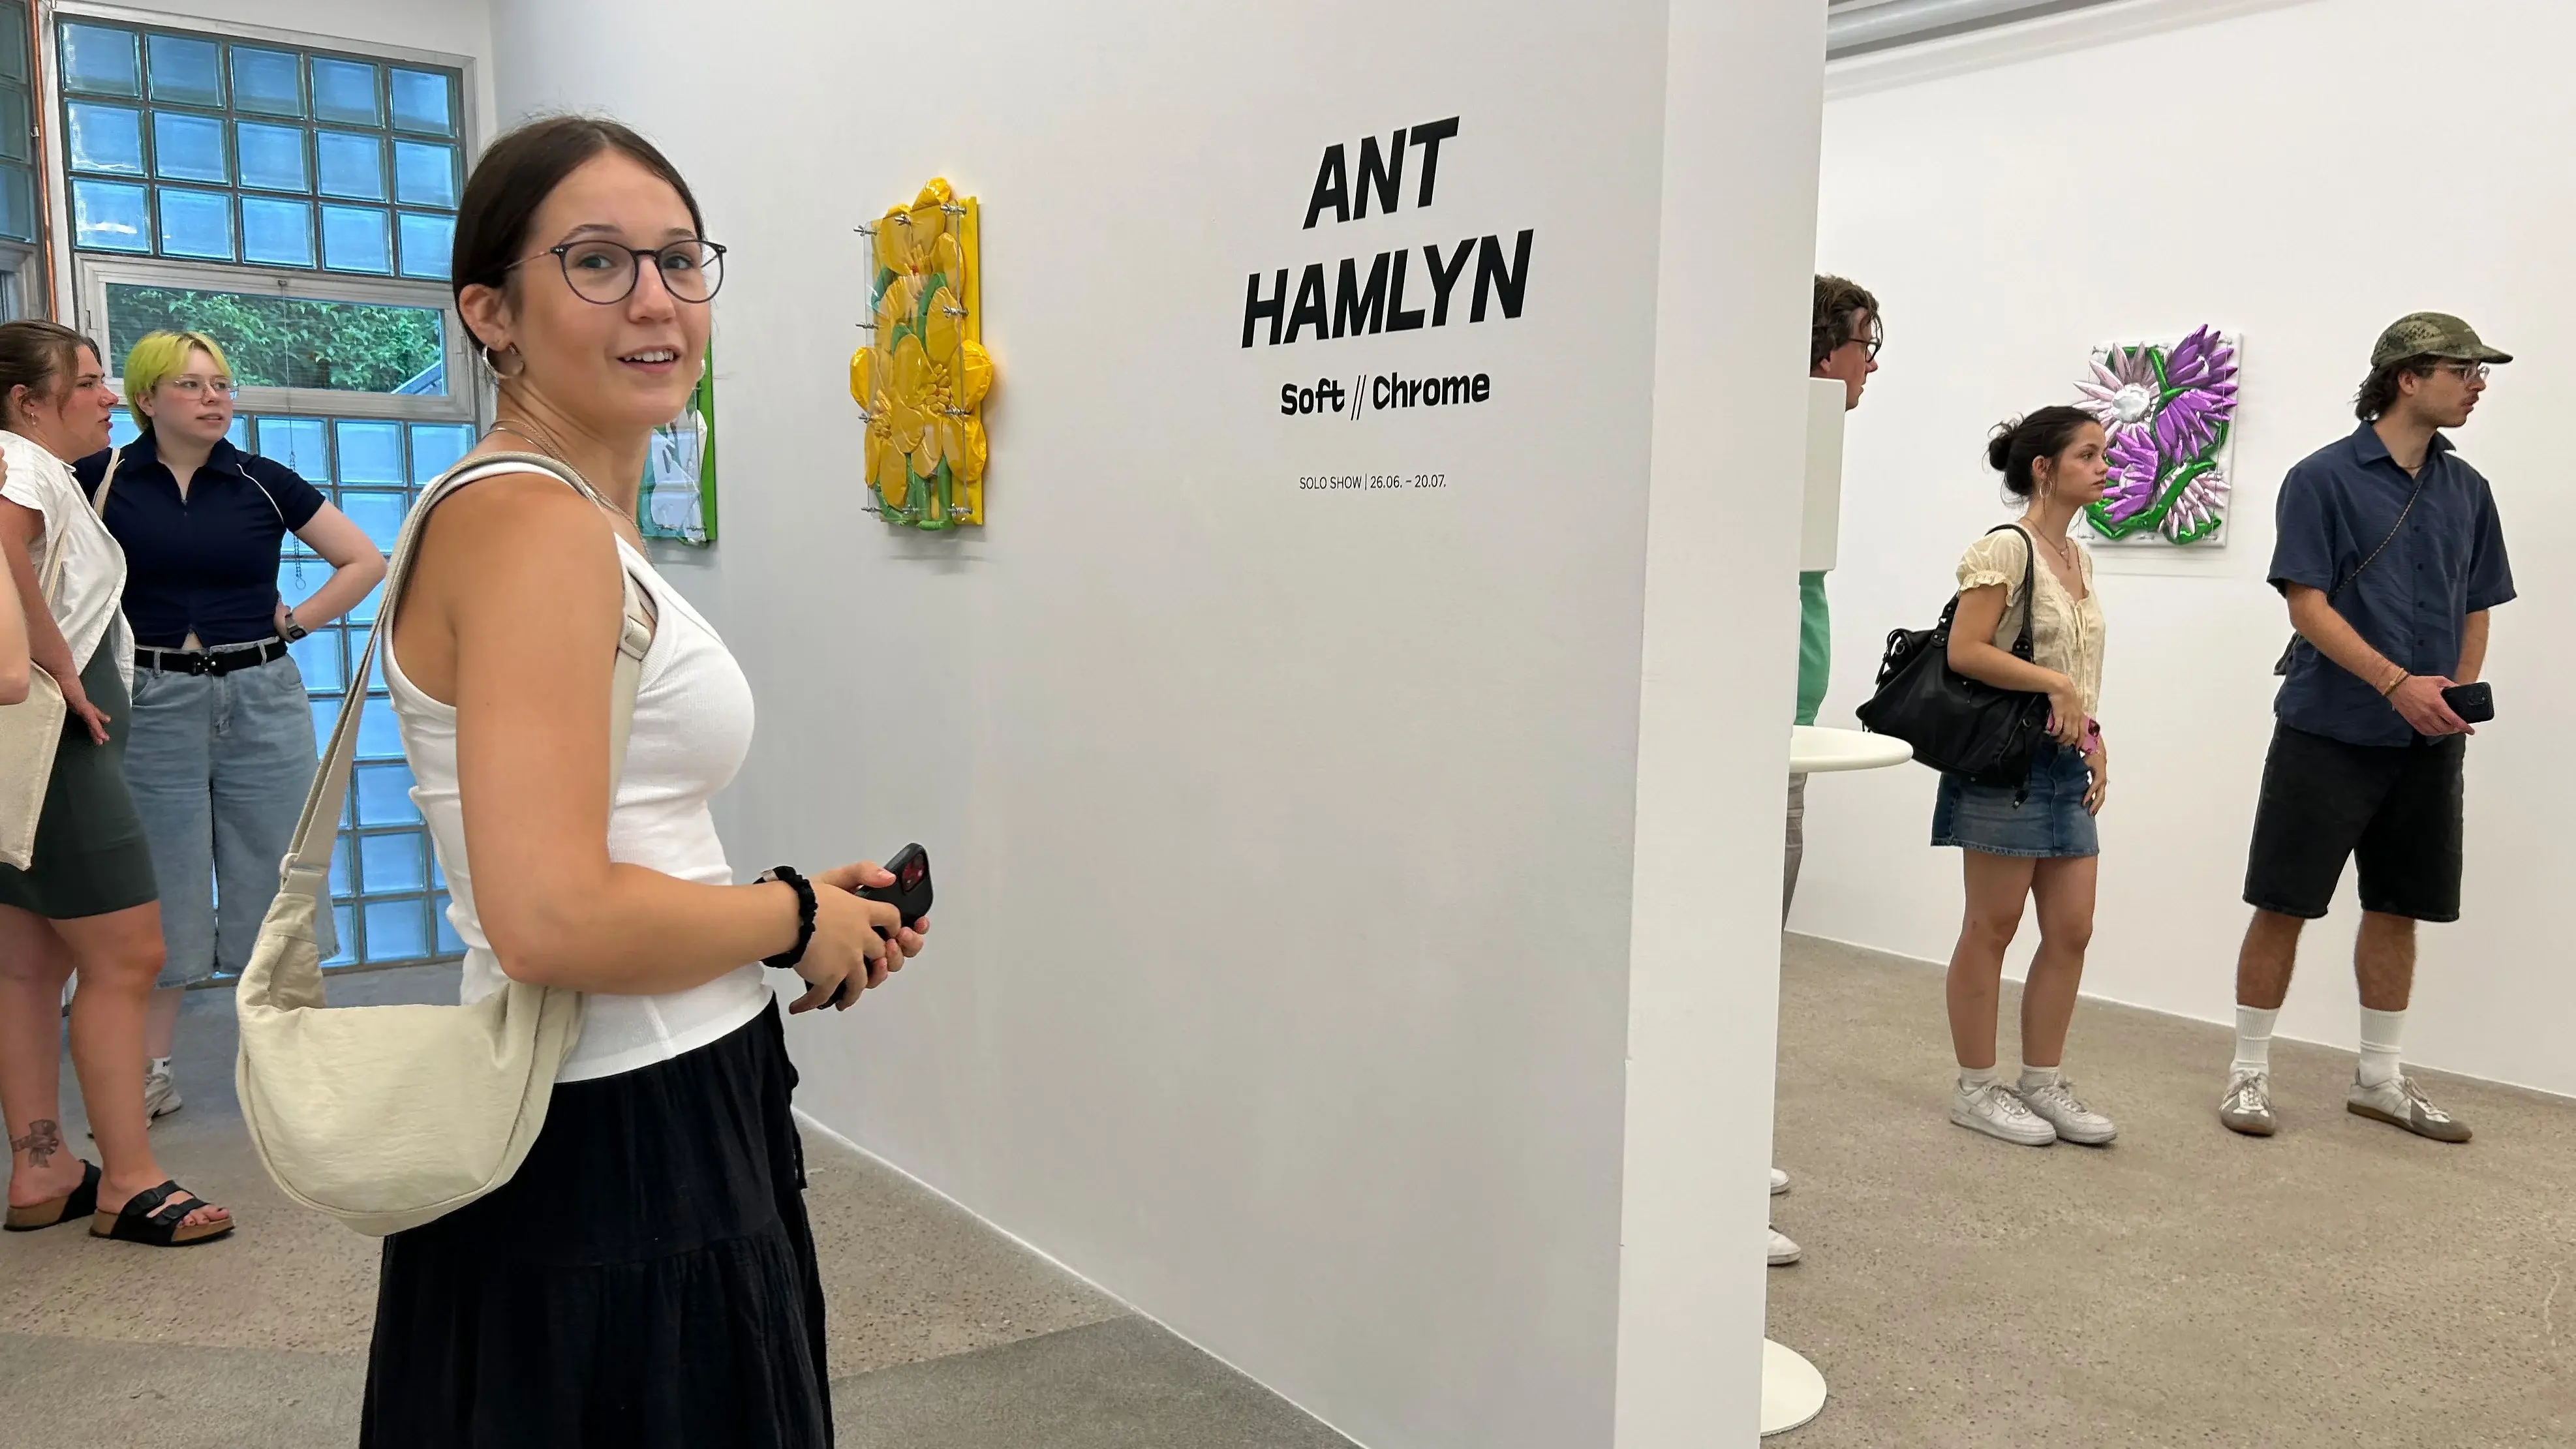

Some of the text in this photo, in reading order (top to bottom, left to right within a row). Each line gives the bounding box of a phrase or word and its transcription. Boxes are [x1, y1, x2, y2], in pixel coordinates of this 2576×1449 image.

[1302, 115, 1460, 230] ANT
[1241, 228, 1534, 349] HAMLYN
[1281, 378, 1345, 416] Soft
[1372, 371, 1490, 410] Chrome
[1299, 476, 1327, 489] SOLO
[1330, 476, 1362, 489] SHOW
[1370, 475, 1403, 489] 26.06.
[1414, 474, 1447, 488] 20.07.
